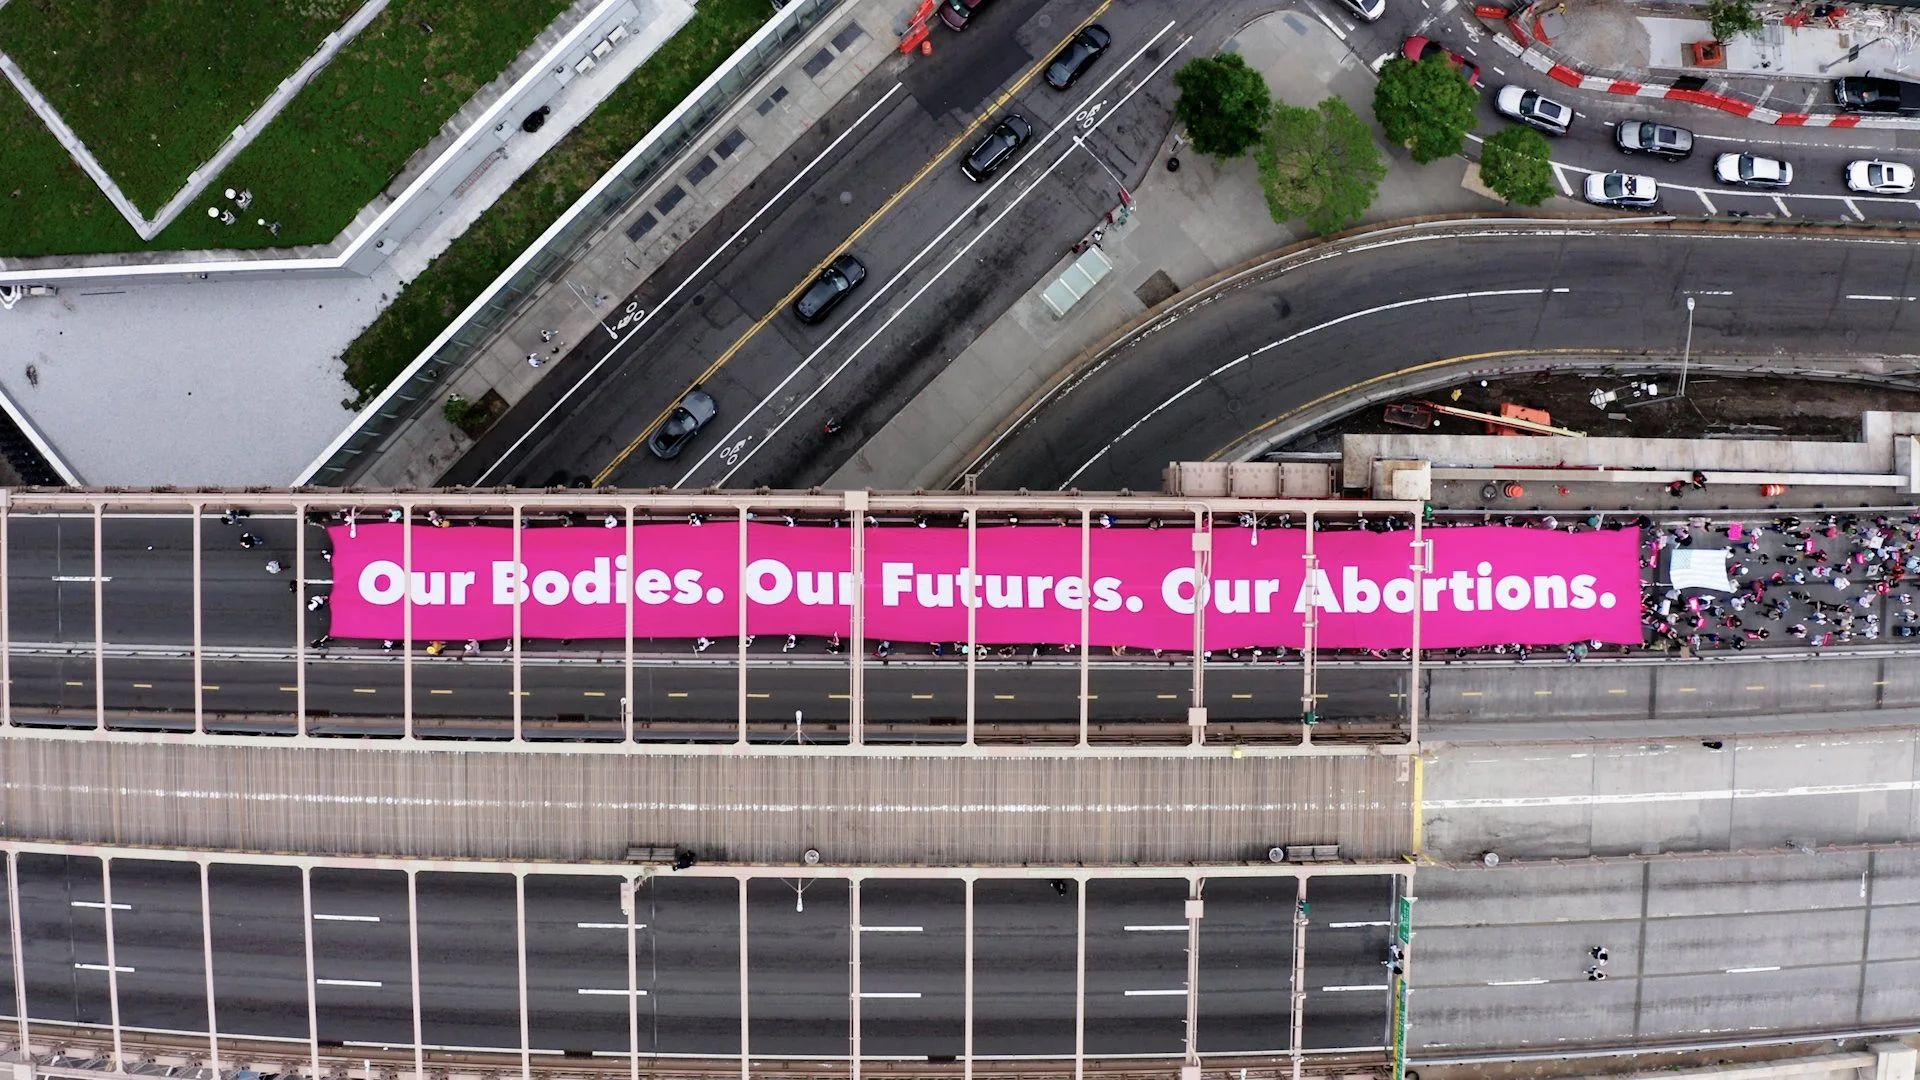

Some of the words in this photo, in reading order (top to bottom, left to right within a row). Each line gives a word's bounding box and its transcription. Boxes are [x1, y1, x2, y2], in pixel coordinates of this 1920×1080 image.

[358, 560, 476, 605] Our
[492, 554, 724, 606] Bodies.
[882, 562, 1144, 612] Futures.
[1161, 567, 1279, 614] Our
[1293, 561, 1616, 613] Abortions.
